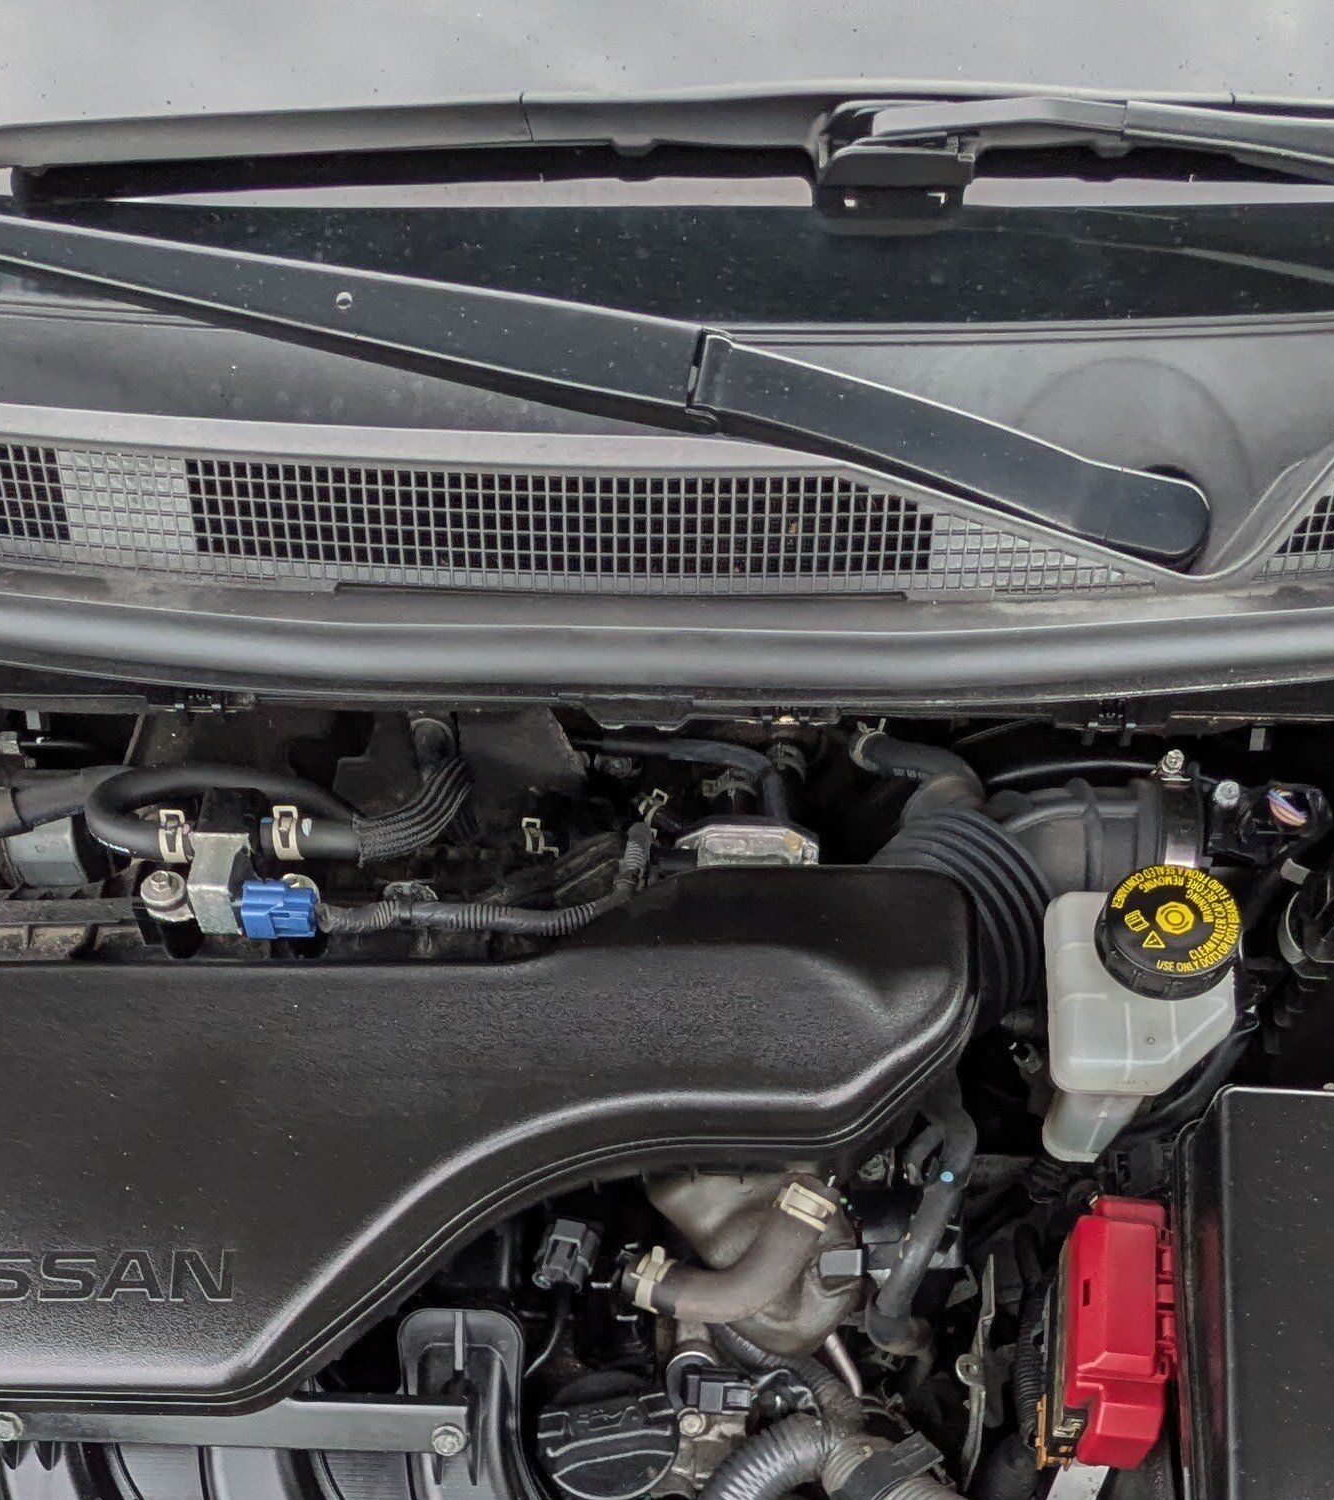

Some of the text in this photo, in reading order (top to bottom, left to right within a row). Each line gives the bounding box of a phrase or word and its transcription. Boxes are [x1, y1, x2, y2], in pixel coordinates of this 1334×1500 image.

[1143, 866, 1175, 879] SEALED
[1178, 867, 1184, 875] A
[1184, 868, 1210, 884] FROM
[1208, 880, 1230, 899] FLUID
[1186, 889, 1214, 922] WARNING
[1139, 875, 1226, 960] CLEAN FILLER CAP BEFORE REMOVING
[1218, 943, 1231, 954] OR
[1156, 960, 1174, 971] USE
[1177, 960, 1198, 972] ONLY
